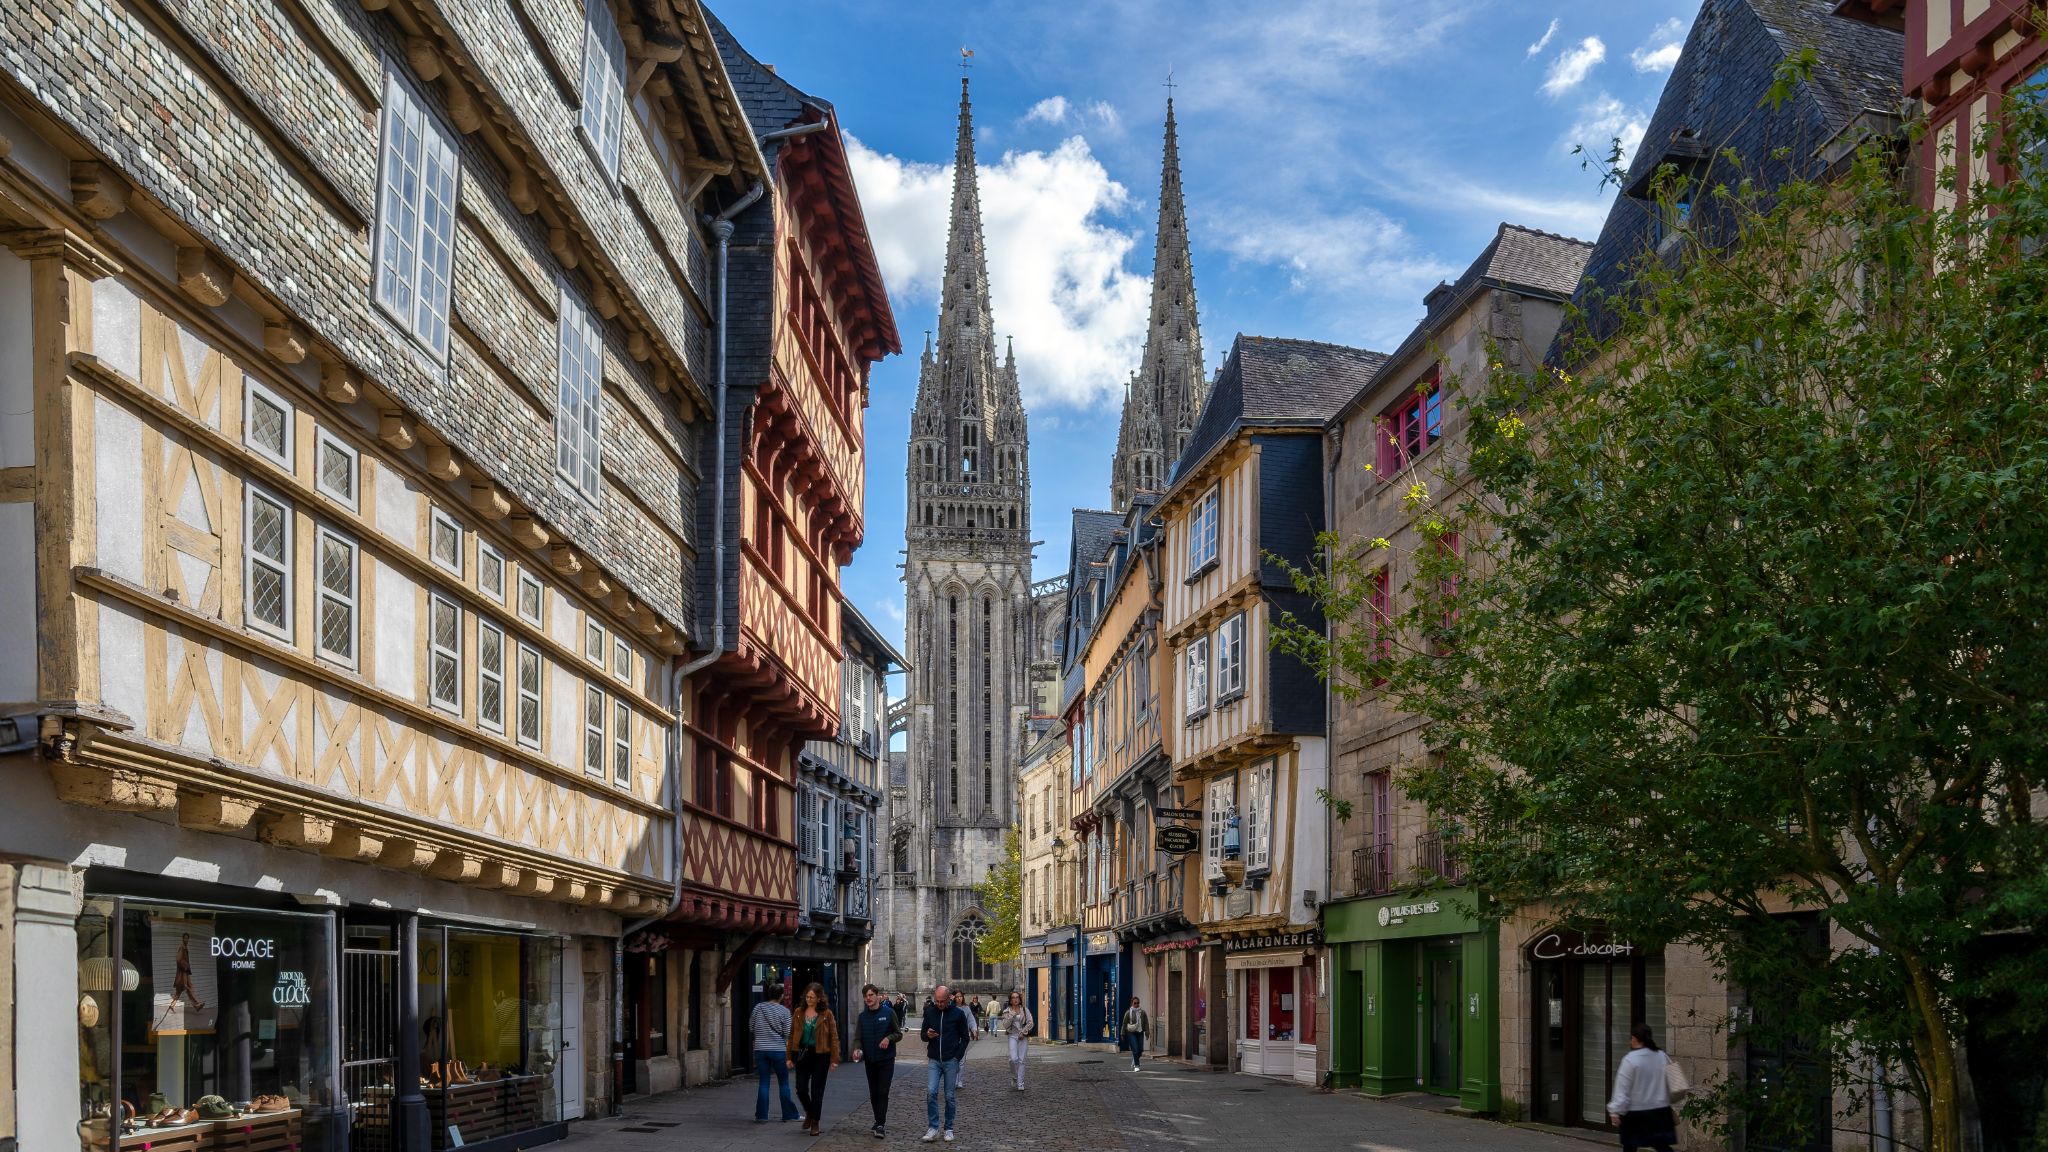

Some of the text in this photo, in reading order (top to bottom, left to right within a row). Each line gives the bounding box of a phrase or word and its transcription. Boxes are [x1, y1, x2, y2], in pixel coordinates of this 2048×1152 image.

[1390, 905, 1410, 918] PALAIS
[1410, 903, 1424, 915] DES
[211, 937, 274, 958] BOCAGE
[1226, 933, 1314, 951] MACARONERIE
[231, 960, 256, 969] HOMME
[280, 971, 304, 981] AROUND
[294, 978, 307, 988] THE
[273, 985, 311, 1004] CLOCK
